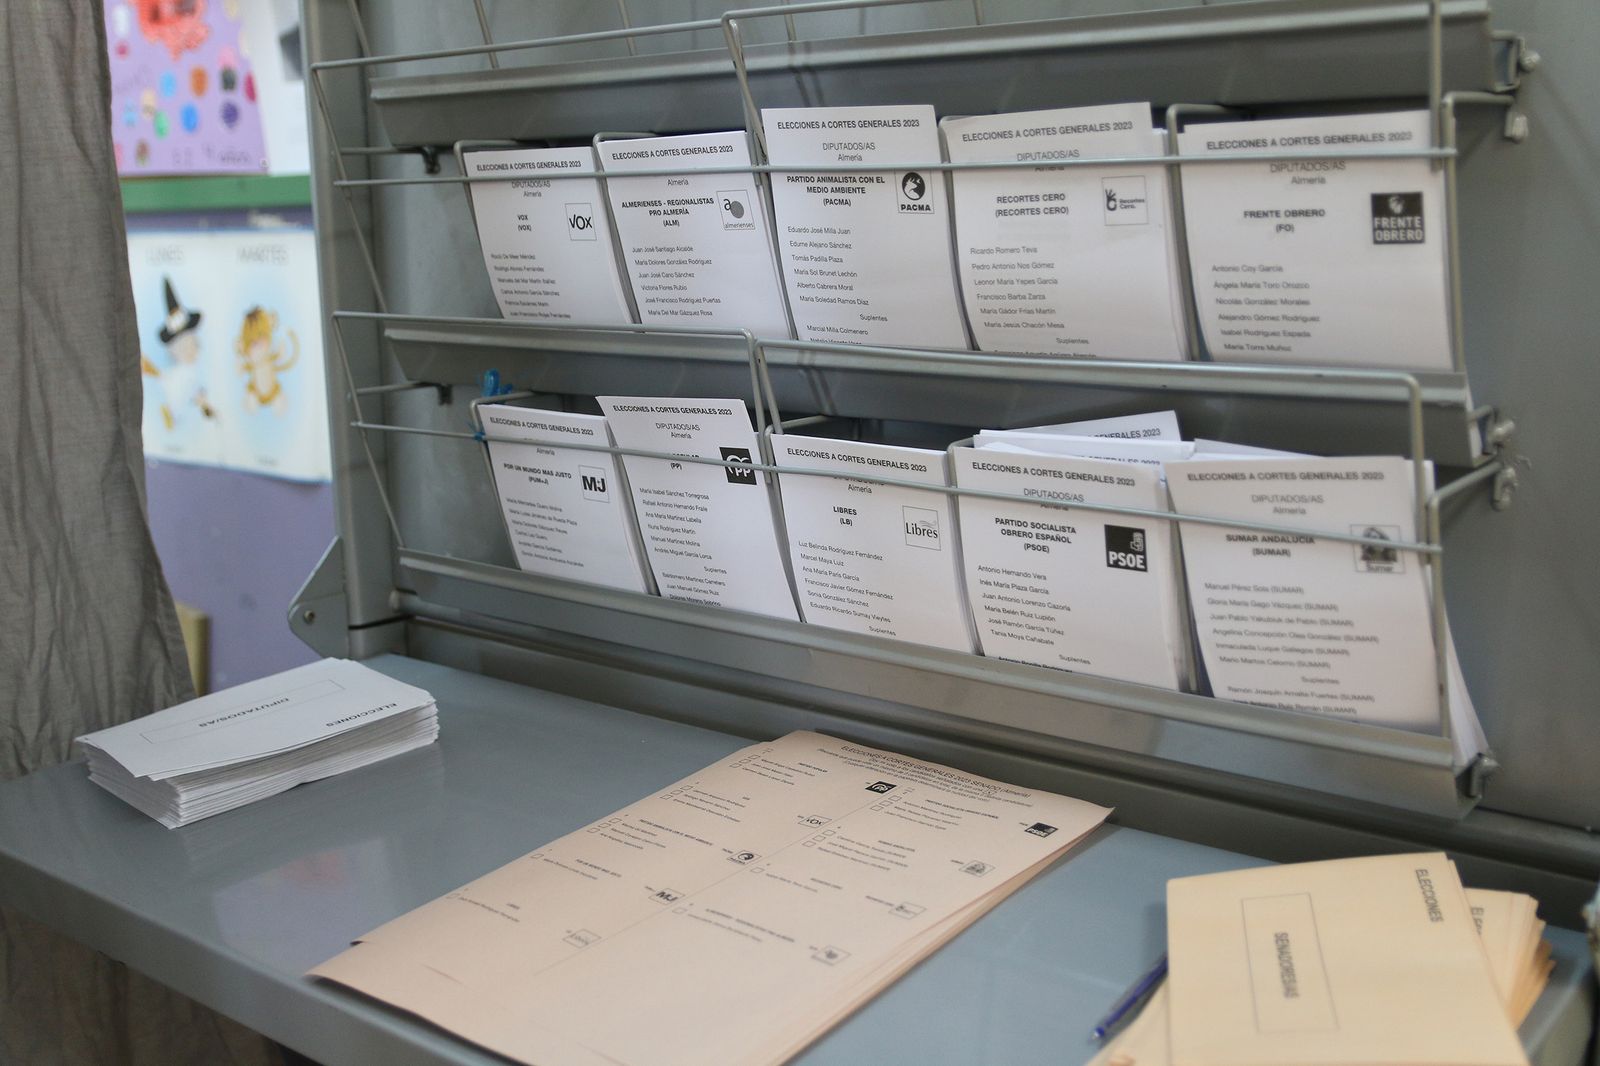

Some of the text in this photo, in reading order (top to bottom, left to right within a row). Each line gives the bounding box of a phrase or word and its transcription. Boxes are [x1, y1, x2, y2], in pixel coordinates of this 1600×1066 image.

[777, 121, 820, 129] ELECCIONES
[827, 120, 856, 128] CORTES
[857, 119, 901, 128] GENERALES
[902, 119, 919, 127] 2023
[962, 130, 1013, 142] ELECCIONES
[1022, 126, 1057, 137] CORTES
[1058, 122, 1111, 134] GENERALES
[1113, 121, 1133, 130] 2023
[1206, 131, 1412, 150] ELECCIONES A CORTES GENERALES 2023
[822, 142, 875, 151] DIPUTADOS/AS
[612, 150, 649, 160] ELECCIONES
[655, 148, 680, 157] CORTES
[680, 146, 718, 155] GENERALES
[1016, 149, 1080, 161] DIPUTADOS/AS
[476, 163, 508, 171] ELECCIONES
[514, 162, 536, 170] CORTES
[536, 160, 568, 168] GENERALES
[1270, 162, 1346, 173] DIPUTADOS/AS
[786, 175, 815, 184] PARTIDO
[830, 186, 866, 194] AMBIENTE
[621, 200, 662, 208] ALMERIENSES
[666, 197, 714, 206] REGIONALISTAS
[823, 198, 851, 206] (PACMA)
[996, 193, 1065, 203] RECORTES CERO
[662, 207, 689, 215] ALMERÍA
[995, 206, 1068, 217] (RECORTES CERO)
[1243, 209, 1325, 218] FRENTE OBRERO
[569, 214, 592, 230] VOX
[663, 219, 680, 227] (ALM)
[1374, 217, 1422, 228] FRENTE
[1276, 224, 1294, 232] (FO)
[1375, 230, 1424, 241] OBRERO
[490, 416, 521, 426] ELECCIONES
[526, 421, 548, 430] CORTES
[548, 424, 580, 434] GENERALES
[1142, 428, 1161, 437] 2023
[787, 447, 830, 459] ELECCIONES
[837, 454, 866, 464] CORTES
[866, 457, 909, 470] GENERALES
[910, 463, 926, 472] 2023
[972, 462, 1021, 474] ELECCIONES
[1030, 468, 1063, 478] CORTES
[1065, 471, 1114, 484] GENERALES
[1116, 477, 1135, 486] 2023
[1187, 473, 1247, 481] ELECCIONES
[1257, 472, 1297, 480] CORTES
[1298, 472, 1359, 480] GENERALES
[1361, 472, 1384, 480] 2023
[1024, 488, 1084, 502] DIPUTADOS/AS
[1251, 494, 1324, 503] DIPUTADOS/AS
[833, 506, 857, 515] LIBRES
[839, 517, 852, 526] (LB)
[995, 517, 1076, 533] PARTIDO SOCIALISTA
[906, 522, 938, 538] Libres
[1000, 528, 1071, 543] OBRERO ESPAÑOL
[1225, 534, 1258, 542] SUMAR
[1024, 543, 1049, 553] (PSOE)
[1252, 548, 1290, 556] (SUMAR)
[1108, 551, 1145, 569] PSOE
[326, 702, 398, 727] ELECCIONES
[1416, 868, 1443, 923] ELECCIONES
